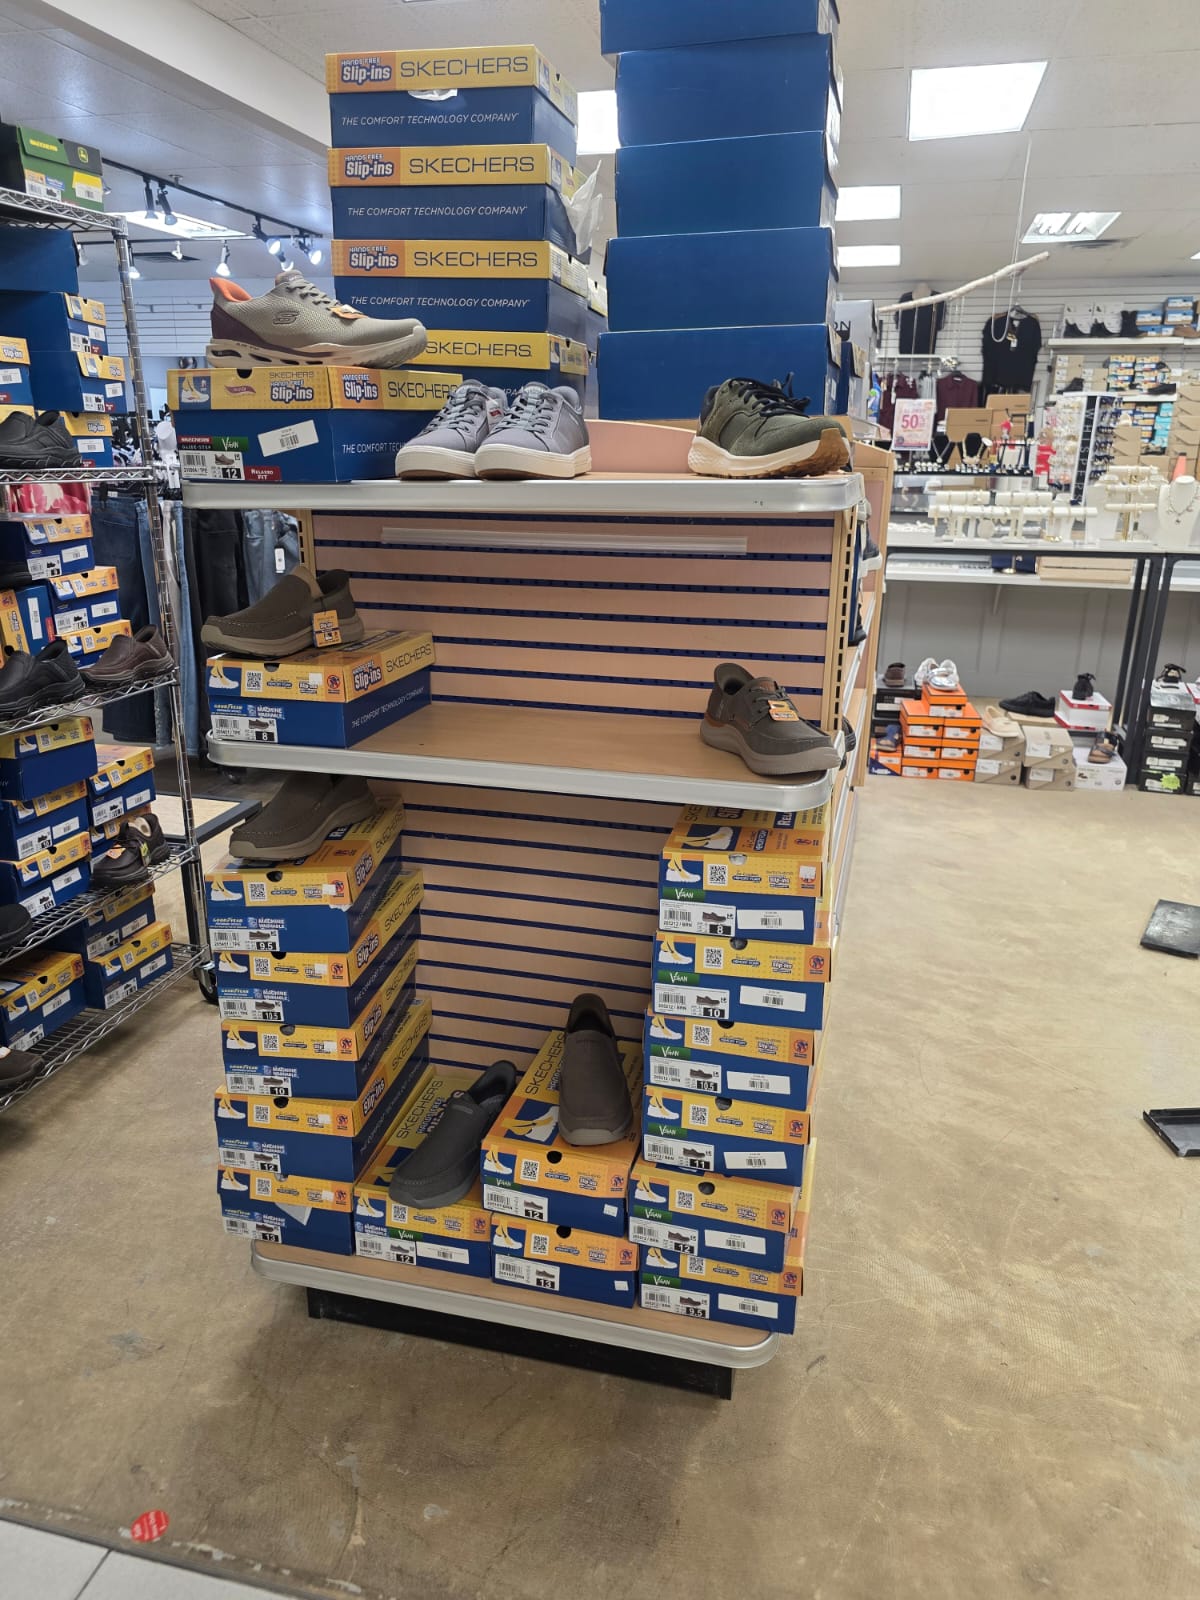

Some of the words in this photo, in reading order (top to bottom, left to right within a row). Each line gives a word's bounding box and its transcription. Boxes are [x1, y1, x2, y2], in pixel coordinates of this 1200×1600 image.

[400, 56, 529, 78] SKECHERS
[342, 66, 392, 84] Slip-ins
[341, 117, 358, 126] THE
[360, 115, 405, 126] COMFORT
[407, 113, 469, 125] TECHNOLOGY
[470, 112, 518, 123] COMPANY
[344, 154, 367, 162] HANDS
[409, 156, 535, 174] SKECHERS
[345, 161, 394, 179] Slip-ins
[348, 207, 364, 216] THE
[366, 207, 411, 216] COMFORT
[414, 206, 477, 216] TECHNOLOGY
[478, 206, 526, 216] COMPANY
[350, 253, 398, 271] Slip-ins
[413, 251, 538, 268] SKECHERS
[351, 296, 368, 305] THE
[369, 297, 415, 306] COMFORT
[417, 297, 479, 307] TECHNOLOGY
[481, 298, 530, 308] COMPANY
[425, 341, 532, 357] SKECHERS
[269, 371, 315, 379] SKECHERS
[271, 387, 314, 403] Slip-ins
[344, 381, 379, 401] Slip-ins
[341, 444, 356, 454] THE
[356, 442, 388, 453] COMFORT
[225, 469, 237, 479] 12
[386, 644, 432, 673] SKECHERS
[354, 667, 383, 691] Slip-ins
[352, 718, 361, 729] THE
[360, 710, 380, 725] COMFORT
[262, 733, 268, 741] 8
[384, 883, 420, 931] SKECHERS
[717, 926, 724, 934] 8
[357, 934, 380, 970] Slip-ins
[708, 1009, 720, 1017] 10
[391, 1014, 428, 1071] SKECHERS
[363, 1078, 386, 1117] Slip-ins
[397, 1080, 444, 1139] SKECHERS
[263, 1163, 274, 1171] 12
[694, 1160, 704, 1168] 11
[528, 1210, 540, 1218] 12
[266, 1233, 275, 1241] 13
[679, 1245, 690, 1253] 12
[400, 1255, 411, 1263] 12
[541, 1279, 552, 1288] 13
[689, 1308, 702, 1318] 9.5
